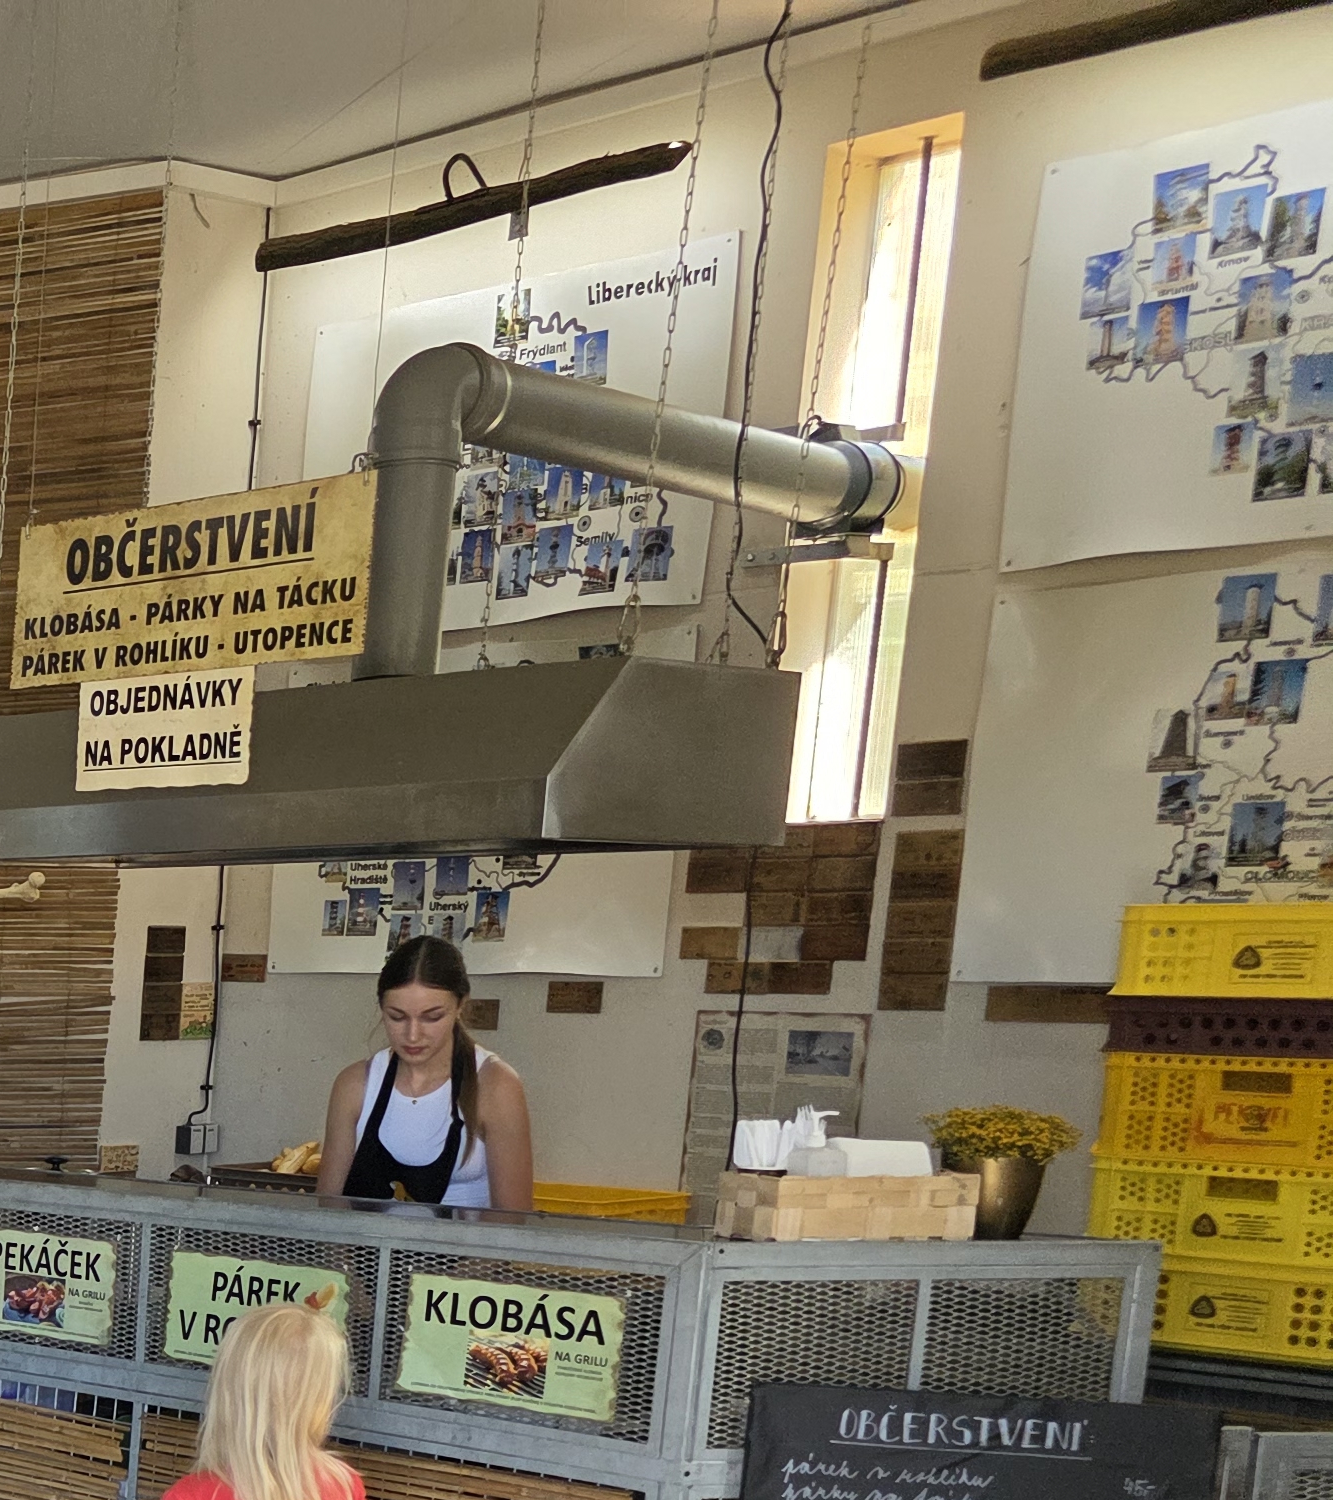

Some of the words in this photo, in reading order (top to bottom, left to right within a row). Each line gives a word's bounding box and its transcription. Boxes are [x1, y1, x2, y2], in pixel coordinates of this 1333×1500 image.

[587, 268, 678, 306] Liberecký
[682, 257, 719, 287] kraj
[519, 339, 568, 361] Frýdlant
[66, 486, 319, 586] OBČERSTVENÍ
[23, 604, 121, 641] KLOBÁSA
[146, 592, 225, 627] PÁRKY
[233, 588, 266, 617] NA
[276, 576, 357, 611] TÁCKU
[21, 647, 86, 678] PÁREK
[94, 647, 108, 670] V
[115, 632, 210, 667] ROHLÍKU
[234, 618, 355, 655] UTOPENCE
[89, 676, 243, 718] OBJEDNÁVKY
[84, 739, 113, 768] NA
[119, 724, 242, 765] POKLADNĚ
[349, 873, 389, 885] Hradiště
[350, 861, 389, 872] Uherské
[428, 901, 469, 913] Uherský
[68, 1286, 82, 1299] NA
[83, 1287, 106, 1302] GRILU
[211, 1265, 301, 1307] PÁREK
[178, 1309, 195, 1342] V
[424, 1288, 605, 1346] KLOBÁSA
[554, 1350, 572, 1364] NA
[574, 1352, 608, 1369] GRILU
[781, 1452, 860, 1484] párek
[866, 1466, 891, 1480] v
[895, 1466, 995, 1489] rohlíku
